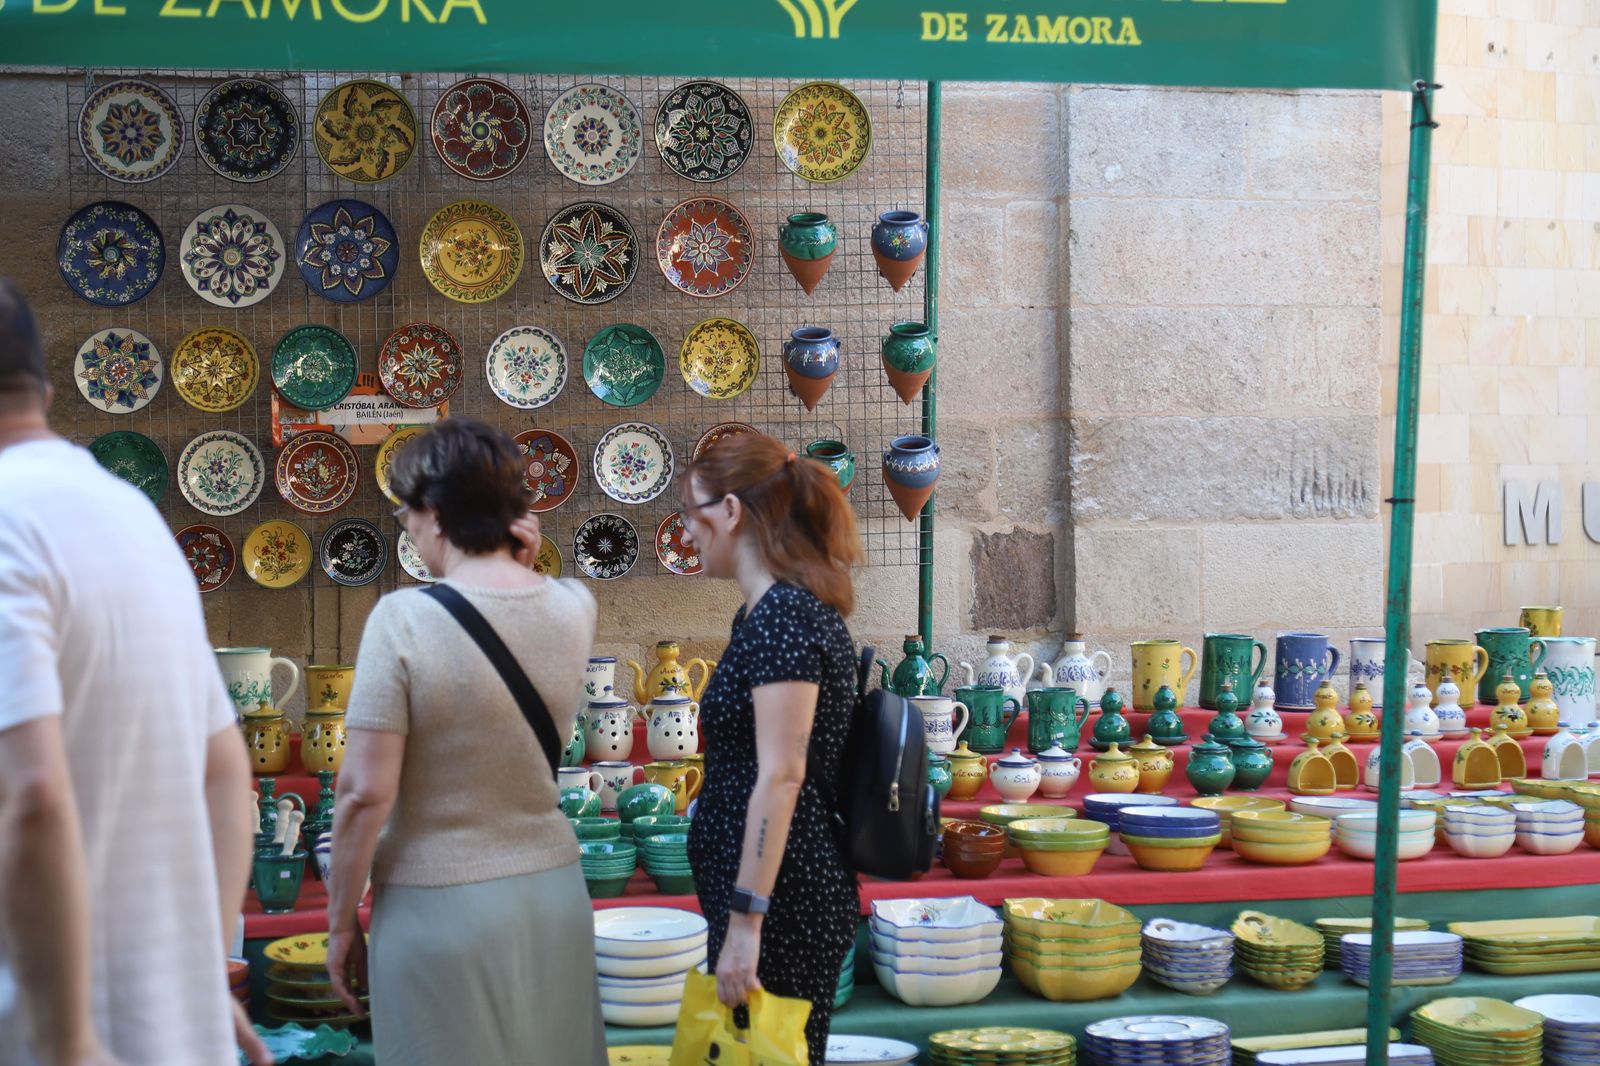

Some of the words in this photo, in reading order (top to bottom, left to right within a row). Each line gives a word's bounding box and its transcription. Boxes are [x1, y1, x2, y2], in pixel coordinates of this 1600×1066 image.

[921, 12, 968, 41] DE
[985, 14, 1142, 45] ZAMORA
[333, 401, 377, 410] CRISTÓBAL
[356, 409, 382, 418] BAILÉN
[383, 410, 404, 419] (Jaén)
[1142, 761, 1161, 772] Sal
